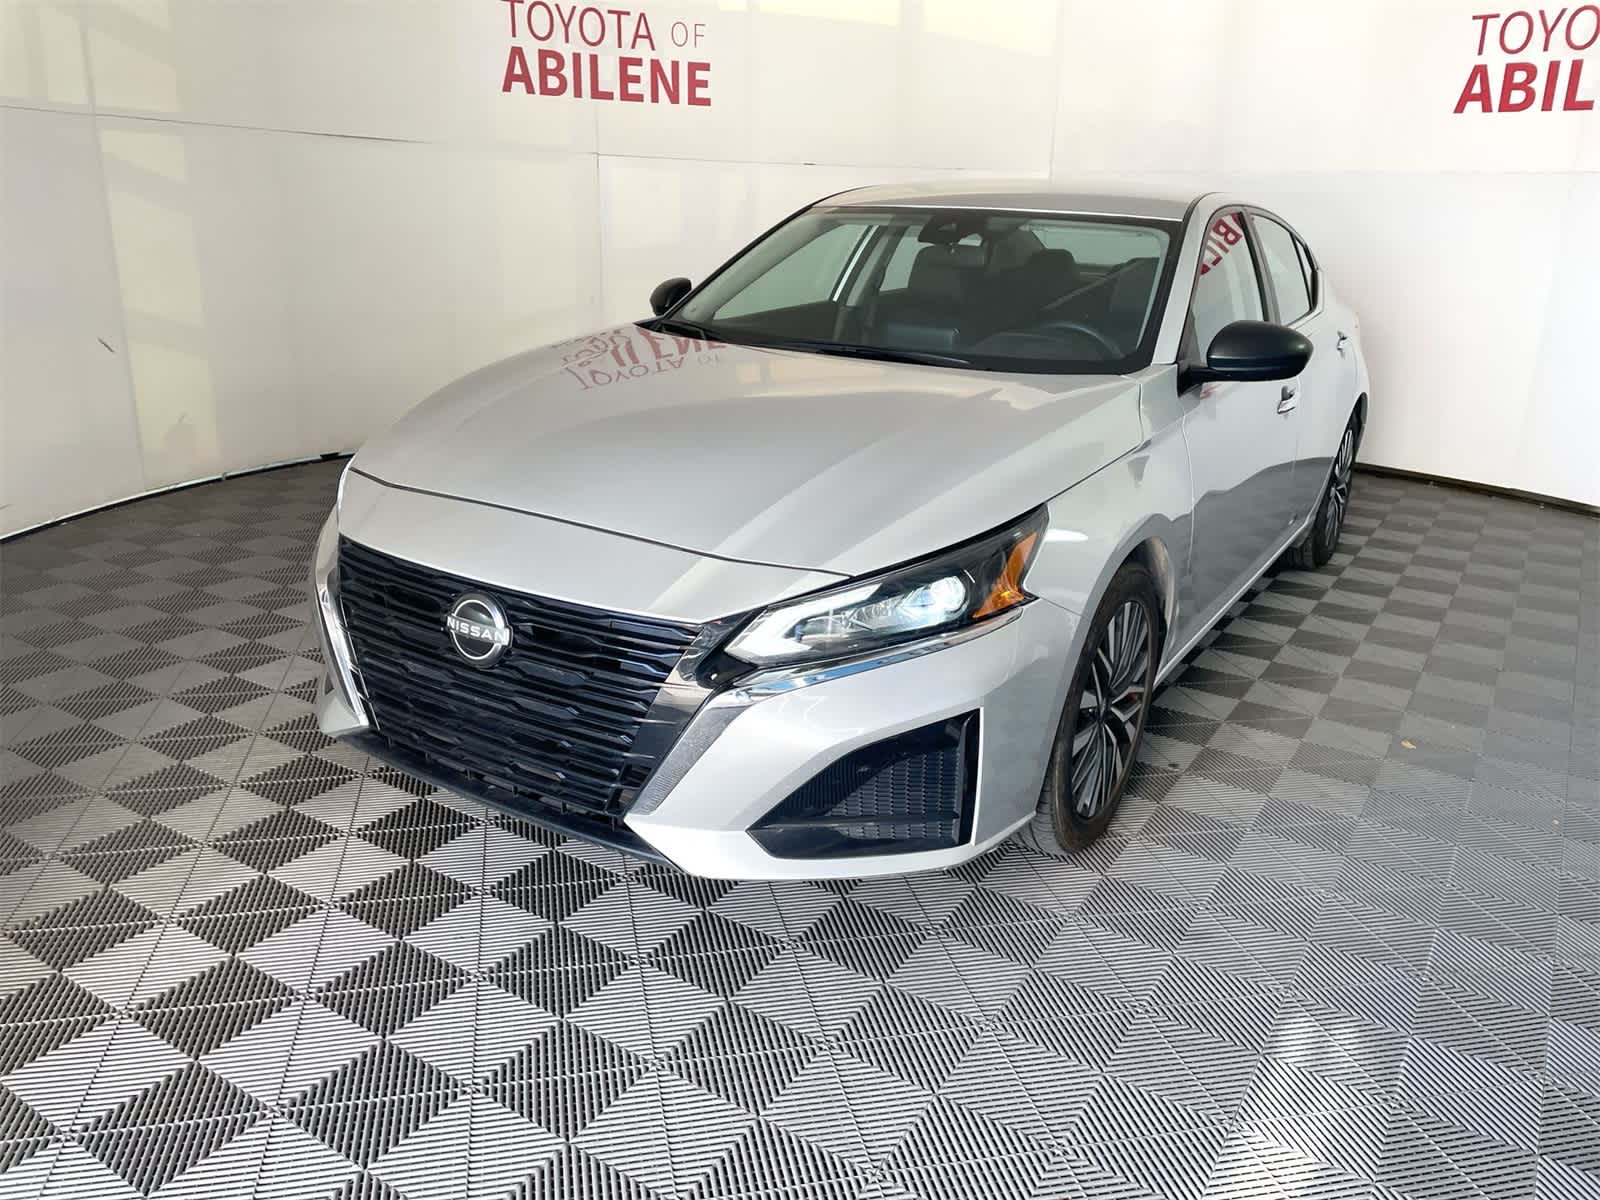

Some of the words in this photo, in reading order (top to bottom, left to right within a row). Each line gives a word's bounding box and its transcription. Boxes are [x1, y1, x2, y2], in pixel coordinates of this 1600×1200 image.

[504, 0, 656, 51] TOYOTA
[671, 21, 706, 48] OF
[1471, 5, 1600, 56] TOYO
[502, 46, 712, 107] ABILENE
[1453, 58, 1595, 113] ABIL
[447, 615, 508, 645] NISSAN
